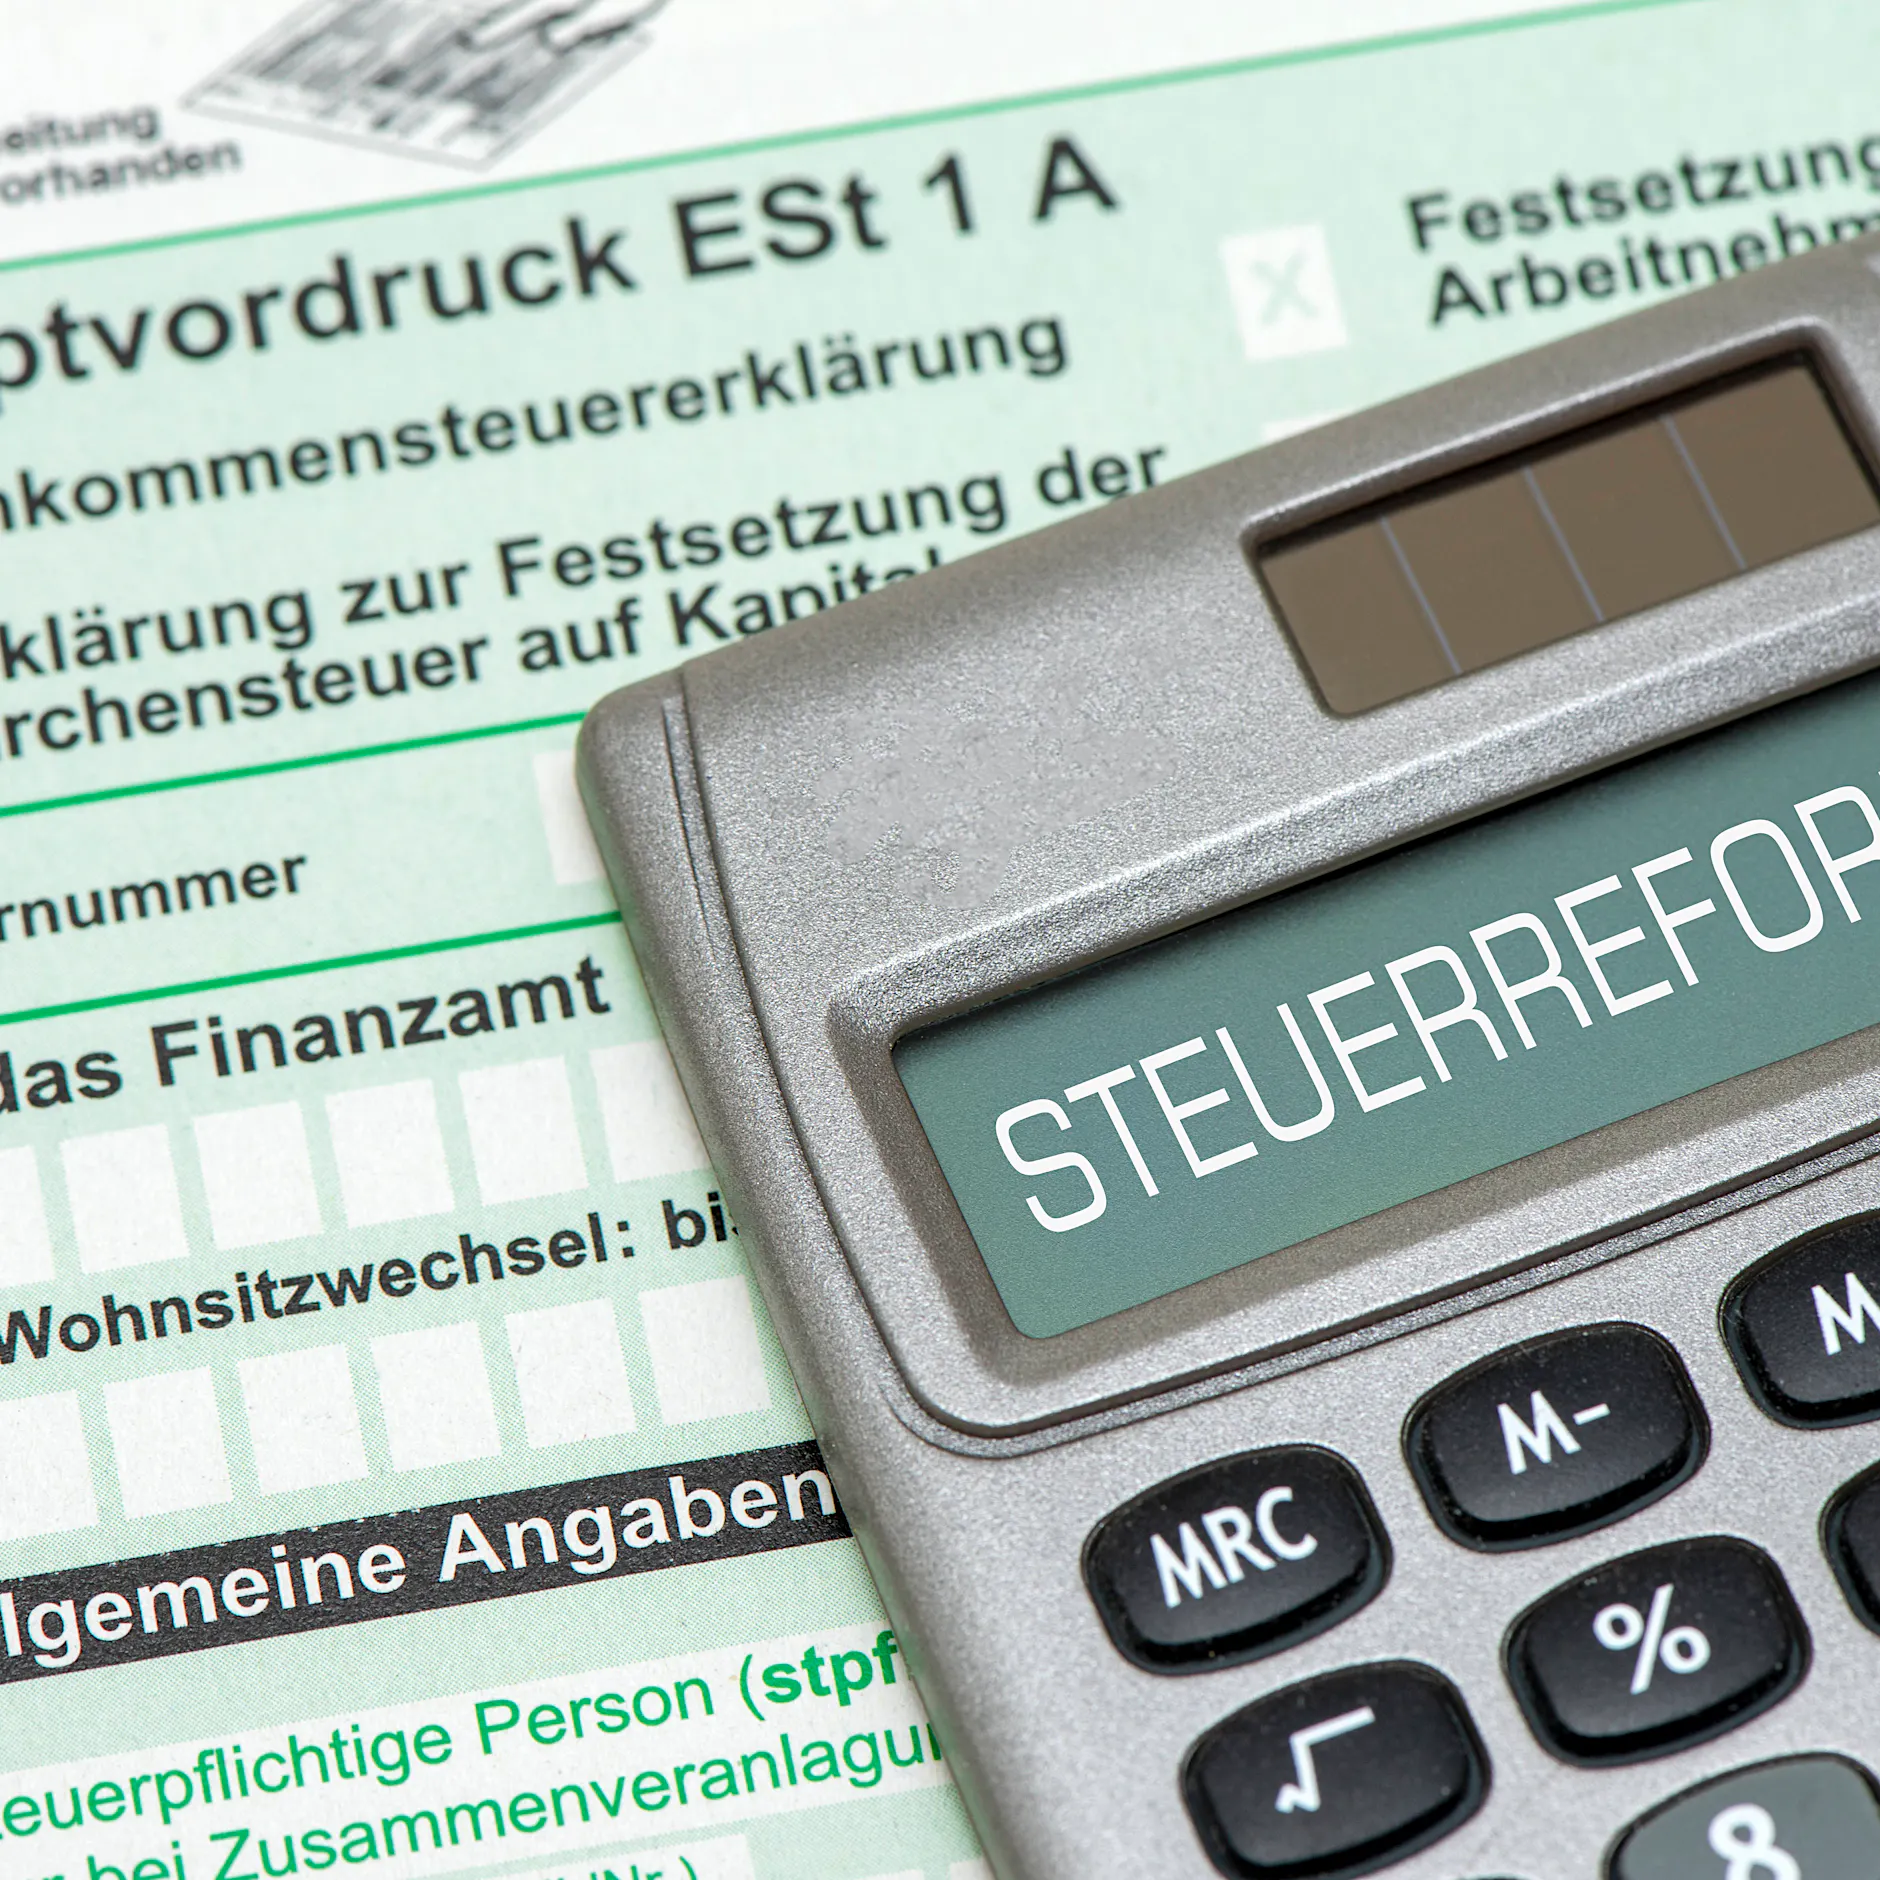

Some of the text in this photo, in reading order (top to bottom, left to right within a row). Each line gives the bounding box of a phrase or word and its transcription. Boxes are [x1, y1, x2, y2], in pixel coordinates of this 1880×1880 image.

[0, 141, 242, 204] orhanden
[673, 176, 886, 279] ESt
[925, 154, 973, 234] 1
[1034, 136, 1117, 222] A
[0, 447, 1164, 680] klärung zur Festsetzung der
[0, 546, 940, 758] rchensteuer auf Kapit
[151, 955, 612, 1087] Finanzamt
[995, 780, 1880, 1233] STEUERREFOR
[0, 1191, 739, 1365] Wohnsitzwechsel: bi
[0, 1470, 835, 1669] lgemeine Angaben
[1150, 1486, 1317, 1608] MRC
[1593, 1584, 1711, 1695] %
[0, 1630, 911, 1840] euerpflichtige Person (stpf
